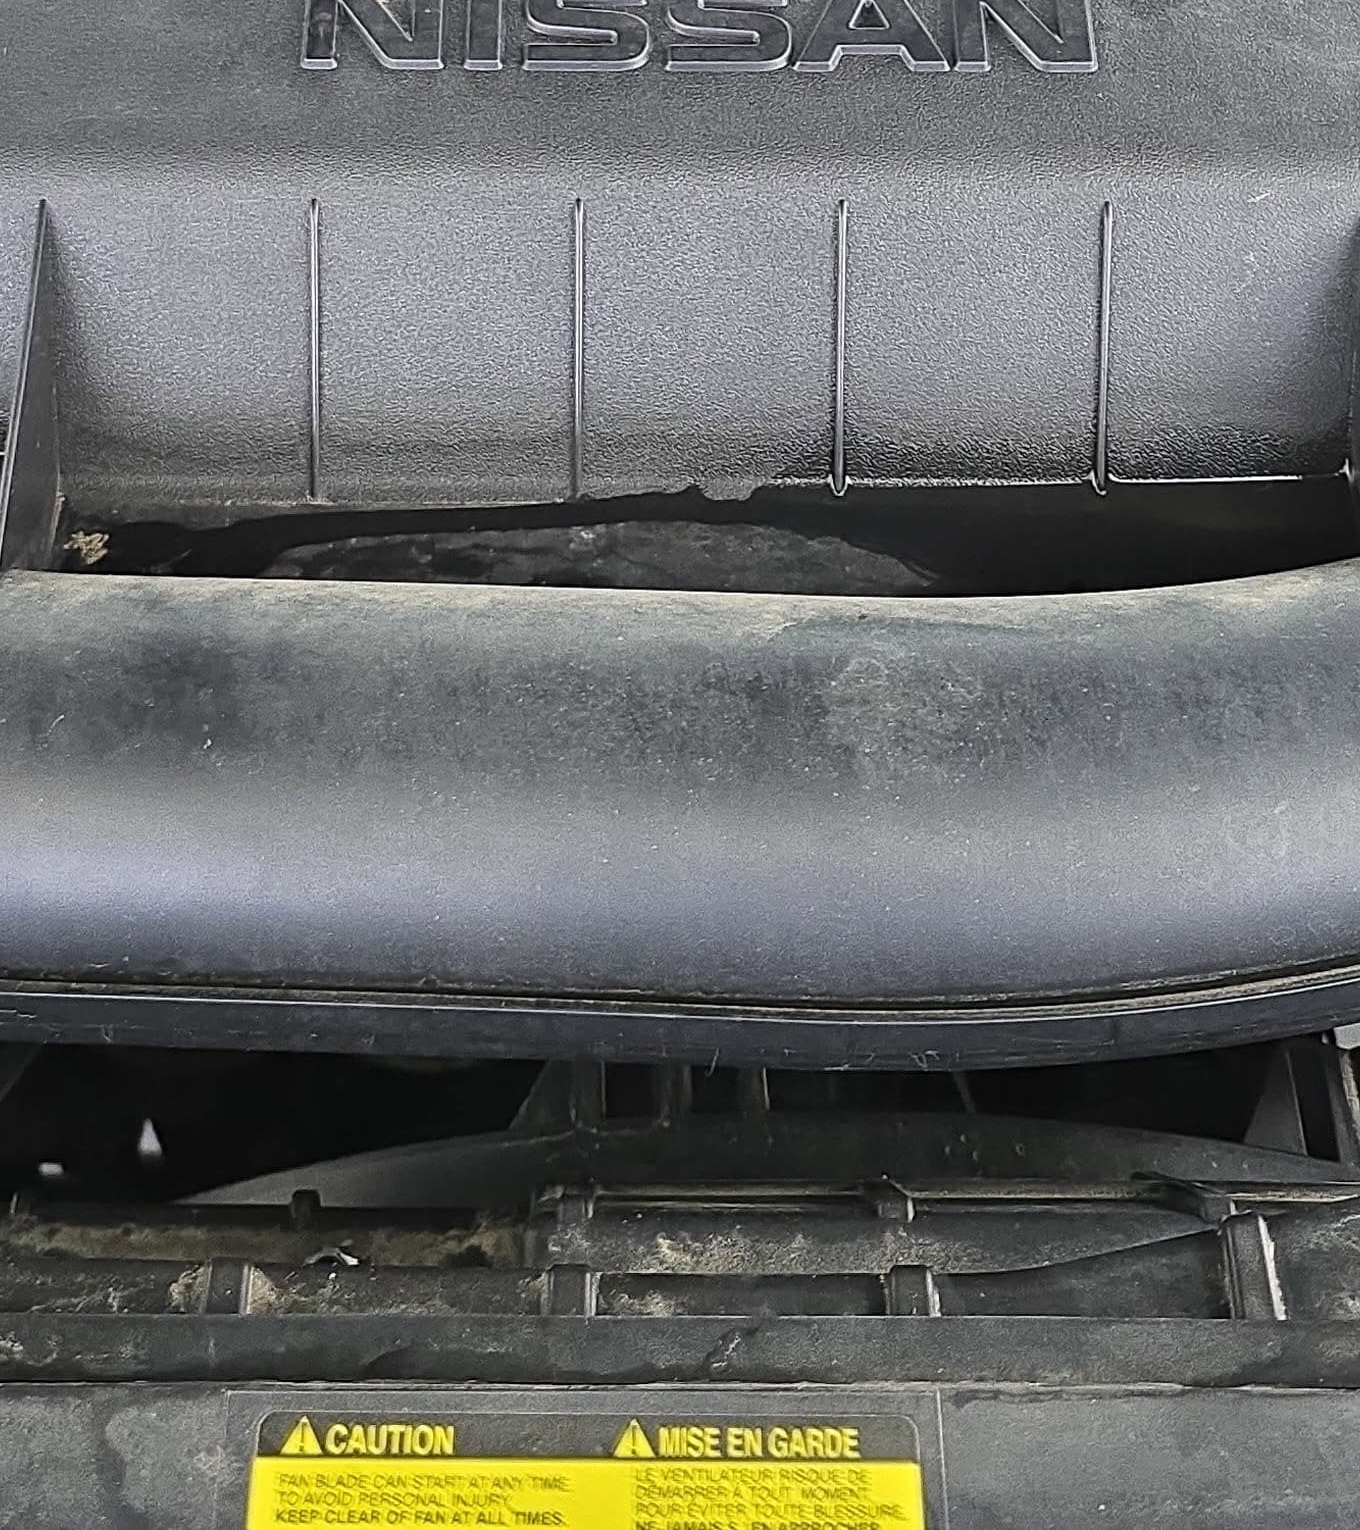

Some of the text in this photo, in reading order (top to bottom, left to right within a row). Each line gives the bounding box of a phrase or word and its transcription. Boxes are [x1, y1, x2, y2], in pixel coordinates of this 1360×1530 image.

[325, 1424, 455, 1455] CAUTION
[658, 1426, 861, 1459] MISE EN GARDE
[278, 1474, 309, 1489] FAN
[316, 1474, 367, 1489] BLADE
[373, 1475, 408, 1489] CAN
[413, 1475, 464, 1490] START
[469, 1476, 488, 1490] AT
[491, 1476, 523, 1490] ANY
[635, 1468, 873, 1484] LE VENTILATEUR RISQUE DE
[278, 1491, 298, 1507] TO
[303, 1491, 352, 1507] AVOID
[358, 1492, 446, 1507] PERSONAL
[752, 1485, 790, 1501] TOUT
[276, 1509, 319, 1524] KEEP
[324, 1509, 379, 1524] CLEAR
[386, 1510, 408, 1525] OF
[413, 1510, 447, 1525] FAN
[451, 1511, 472, 1525] AT
[478, 1511, 508, 1525] ALL
[635, 1503, 681, 1518] POUR
[753, 1503, 809, 1518] TOUTE
